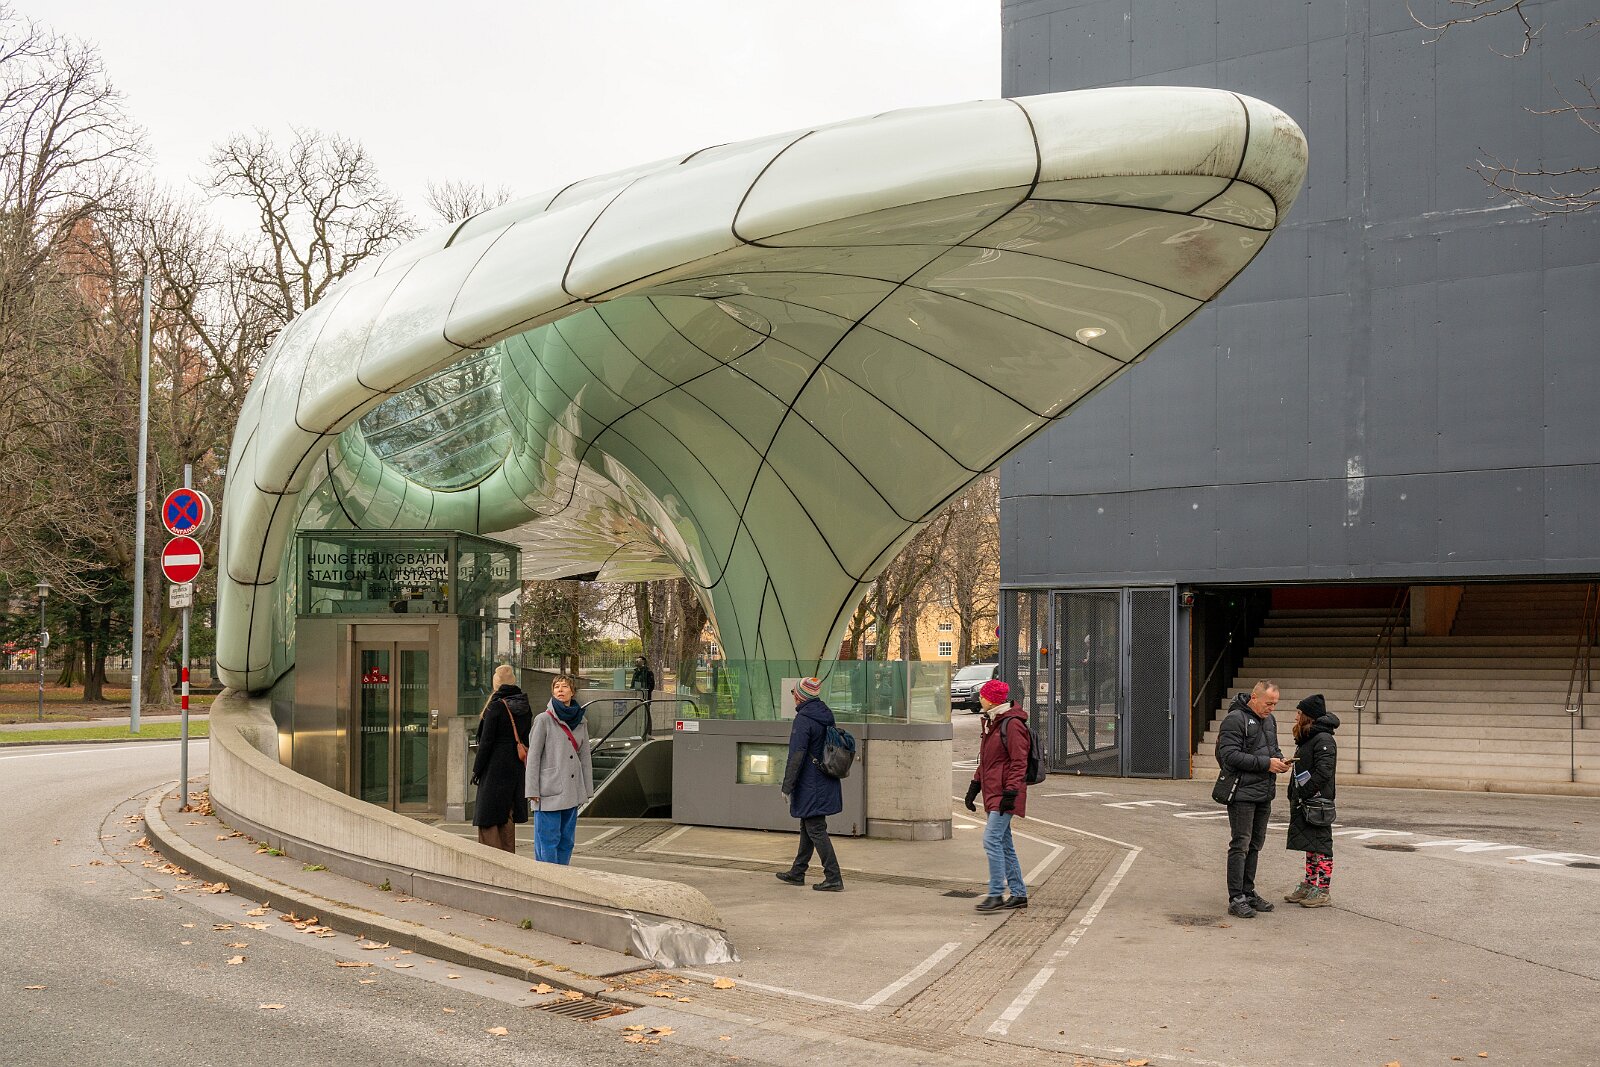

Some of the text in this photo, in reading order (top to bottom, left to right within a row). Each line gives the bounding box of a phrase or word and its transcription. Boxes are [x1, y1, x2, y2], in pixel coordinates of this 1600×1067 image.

[307, 553, 447, 565] HUNGERBURGBAHN
[307, 570, 446, 581] STATION ALTSTADT
